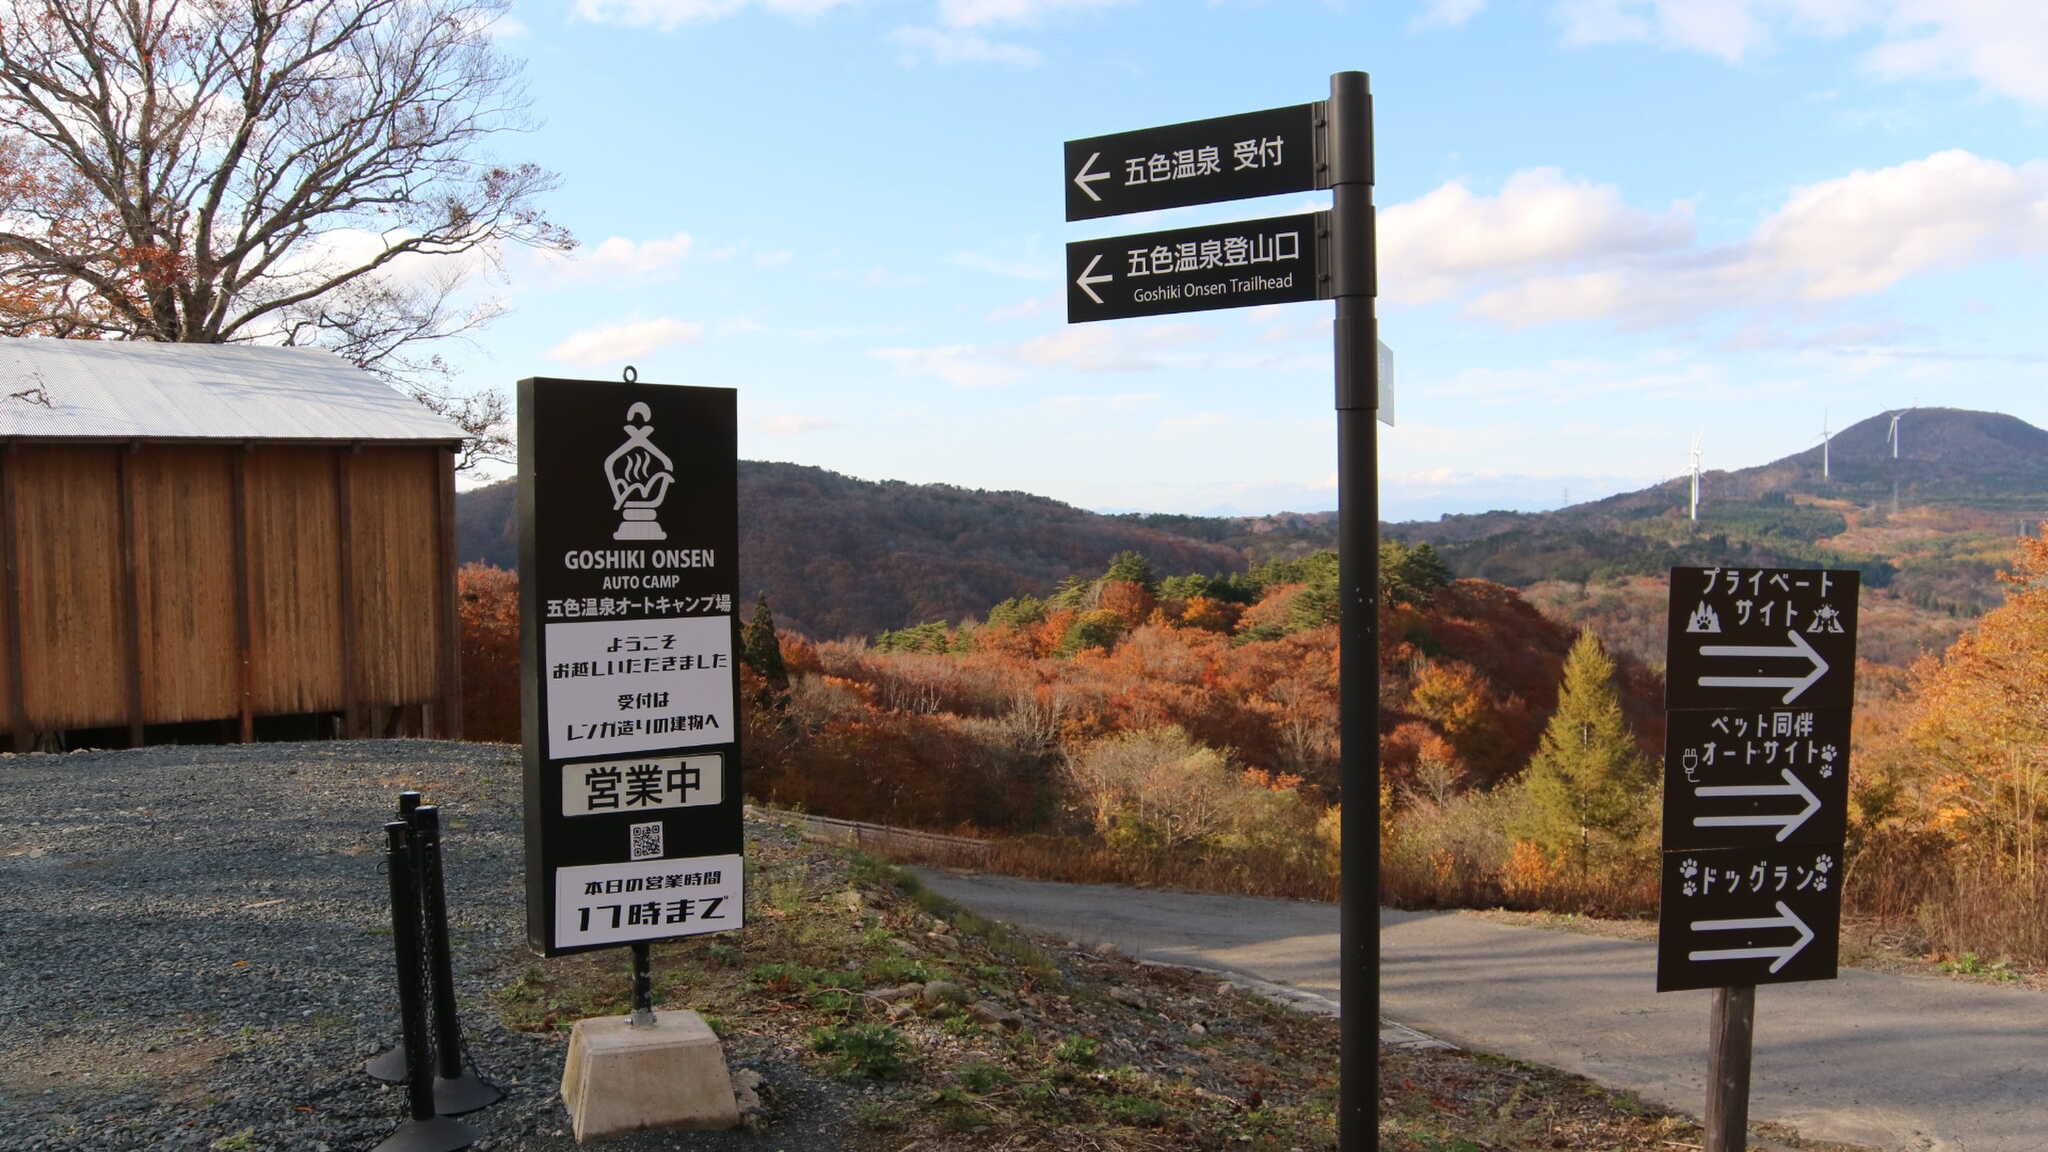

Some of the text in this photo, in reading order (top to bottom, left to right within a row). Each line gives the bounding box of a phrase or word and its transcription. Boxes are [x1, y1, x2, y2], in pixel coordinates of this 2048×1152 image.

[1124, 136, 1284, 186] 五色温泉 受付
[1127, 231, 1300, 278] 五色温泉登山口
[1134, 273, 1293, 303] Goshiki Onsen Trailhead
[564, 549, 715, 569] GOSHIKI ONSEN
[603, 575, 680, 590] AUTO CAMP
[1703, 567, 1833, 598] プライベート
[547, 594, 732, 617] 五色温泉オートキャンプ場
[1736, 600, 1798, 627] サイト
[607, 634, 677, 652] ようこそ
[553, 654, 728, 679] お越しいただきました
[617, 692, 670, 711] 受付は
[1711, 712, 1813, 737] ペット同伴
[1702, 740, 1818, 766] オートサイト
[585, 761, 700, 810] 営業中
[584, 871, 722, 895] 本日の営業時間
[1703, 861, 1814, 895] ドッグラン
[577, 895, 729, 932] 17時まで
